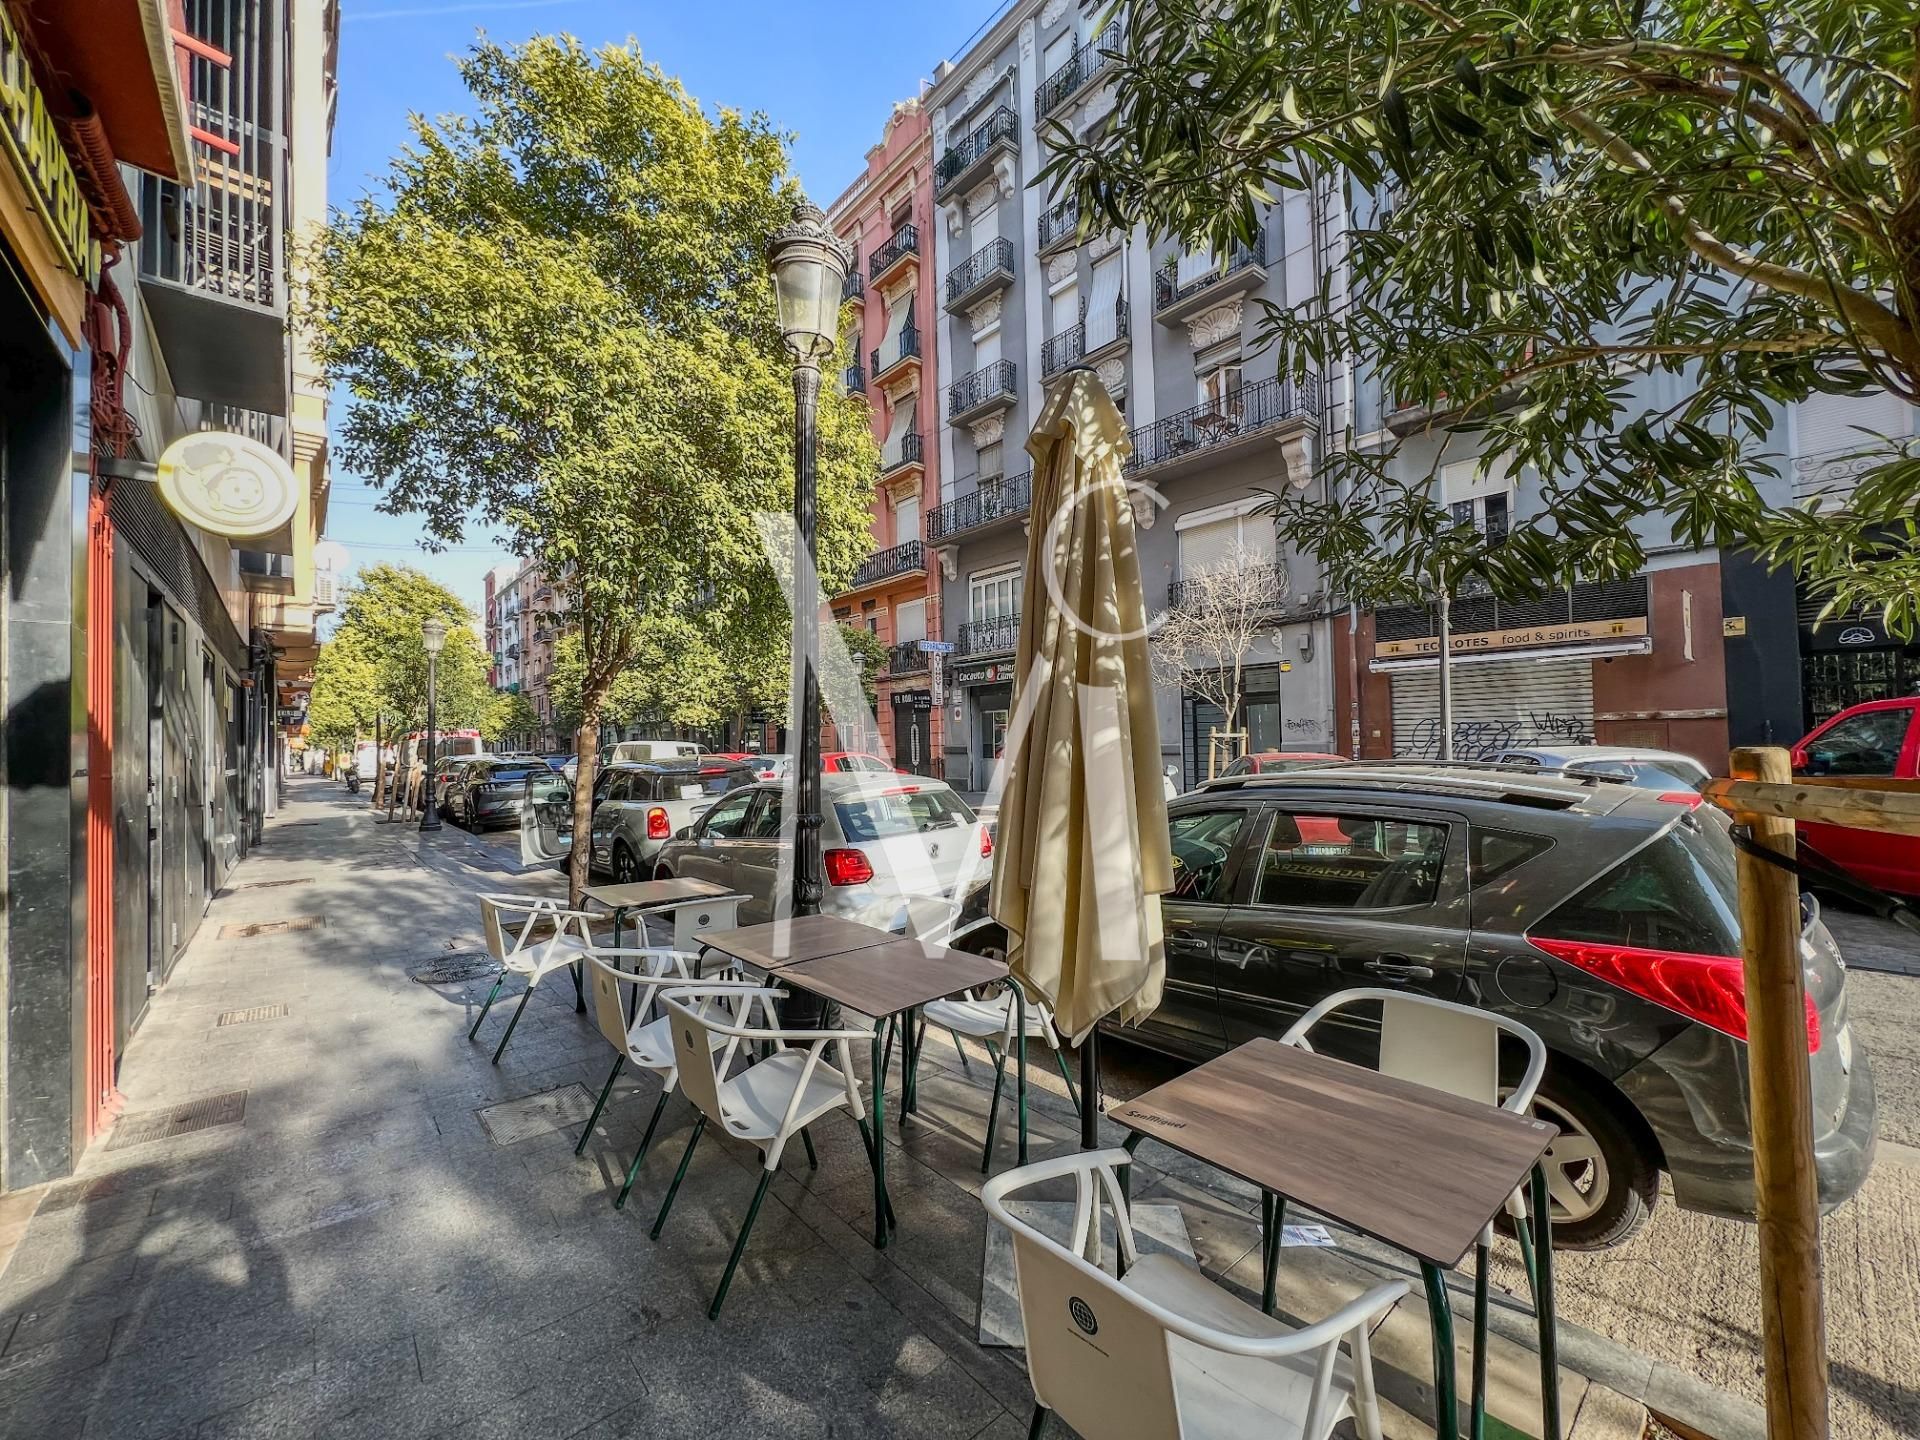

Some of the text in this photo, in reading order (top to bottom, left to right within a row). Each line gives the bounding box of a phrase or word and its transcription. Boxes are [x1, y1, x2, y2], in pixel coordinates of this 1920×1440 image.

[1415, 628, 1591, 651] TECLOTES food & spirits
